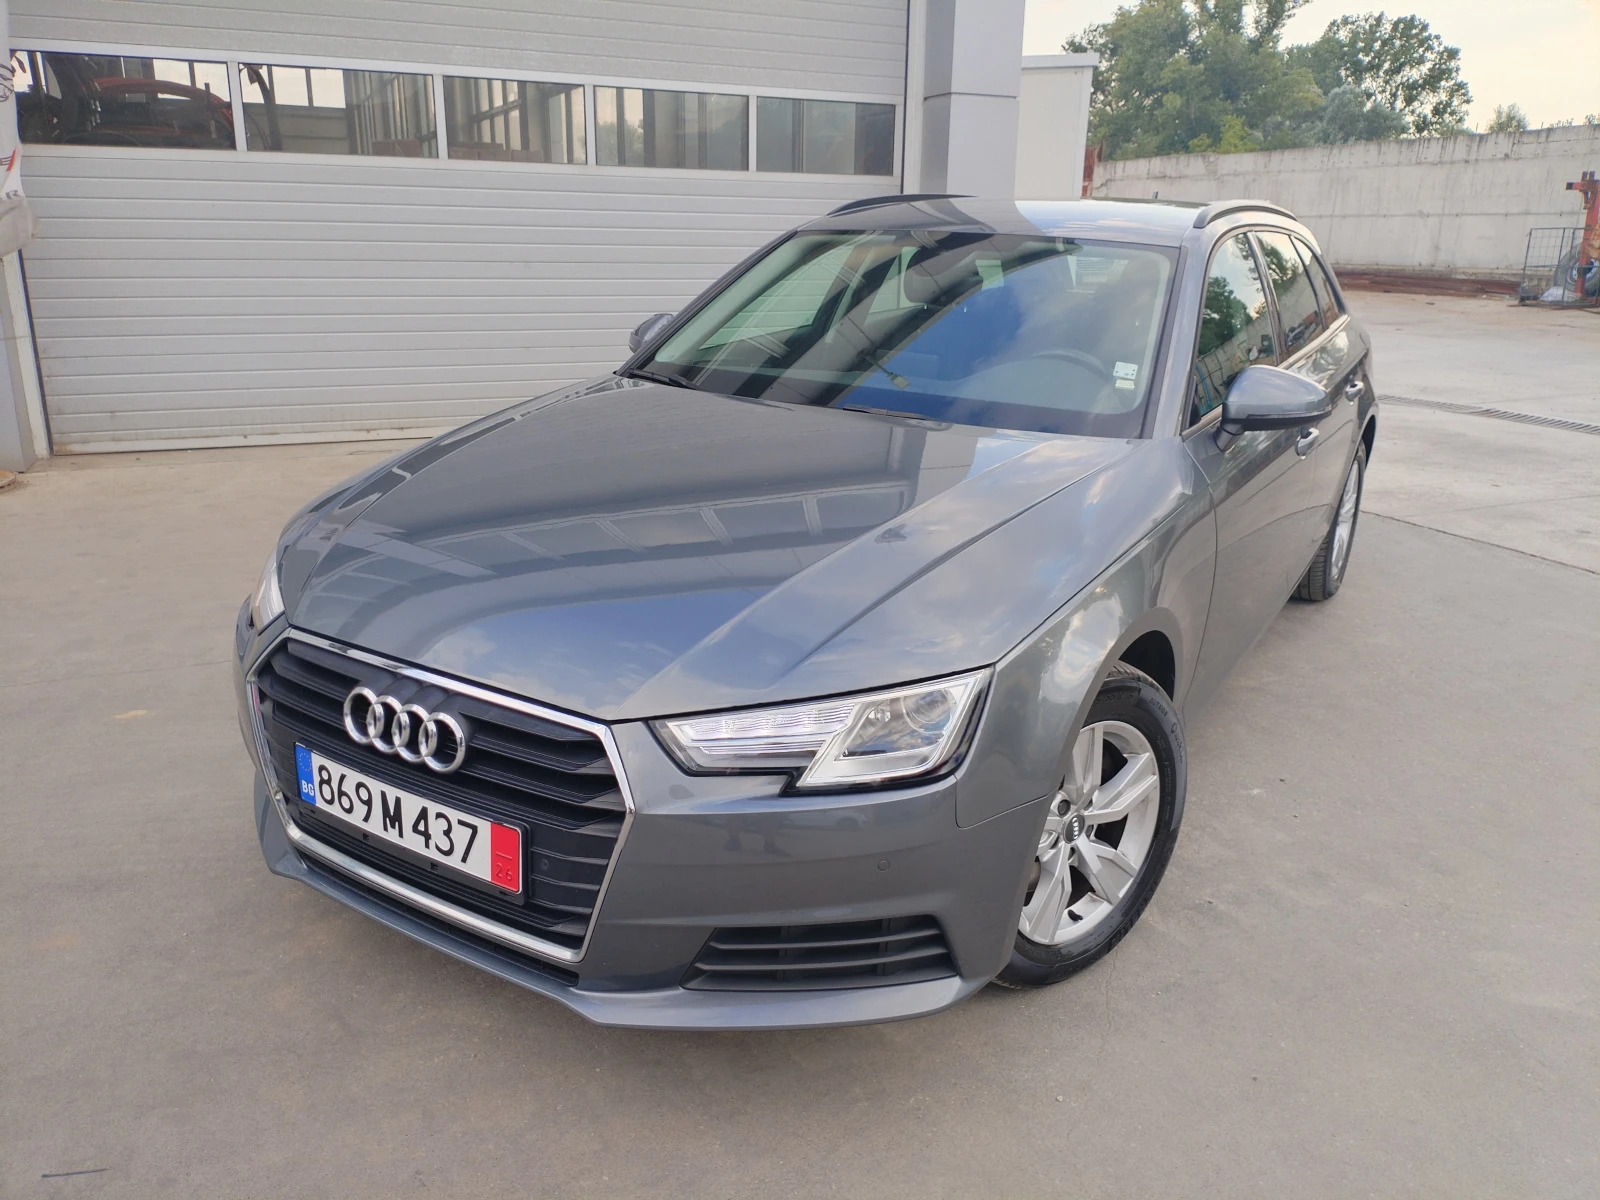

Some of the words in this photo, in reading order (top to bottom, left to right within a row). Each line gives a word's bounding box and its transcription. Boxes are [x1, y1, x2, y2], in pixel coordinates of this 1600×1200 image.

[301, 779, 314, 796] BG
[317, 764, 373, 823] 869
[380, 789, 404, 839] M
[411, 805, 478, 864] 437
[495, 863, 513, 881] 26
